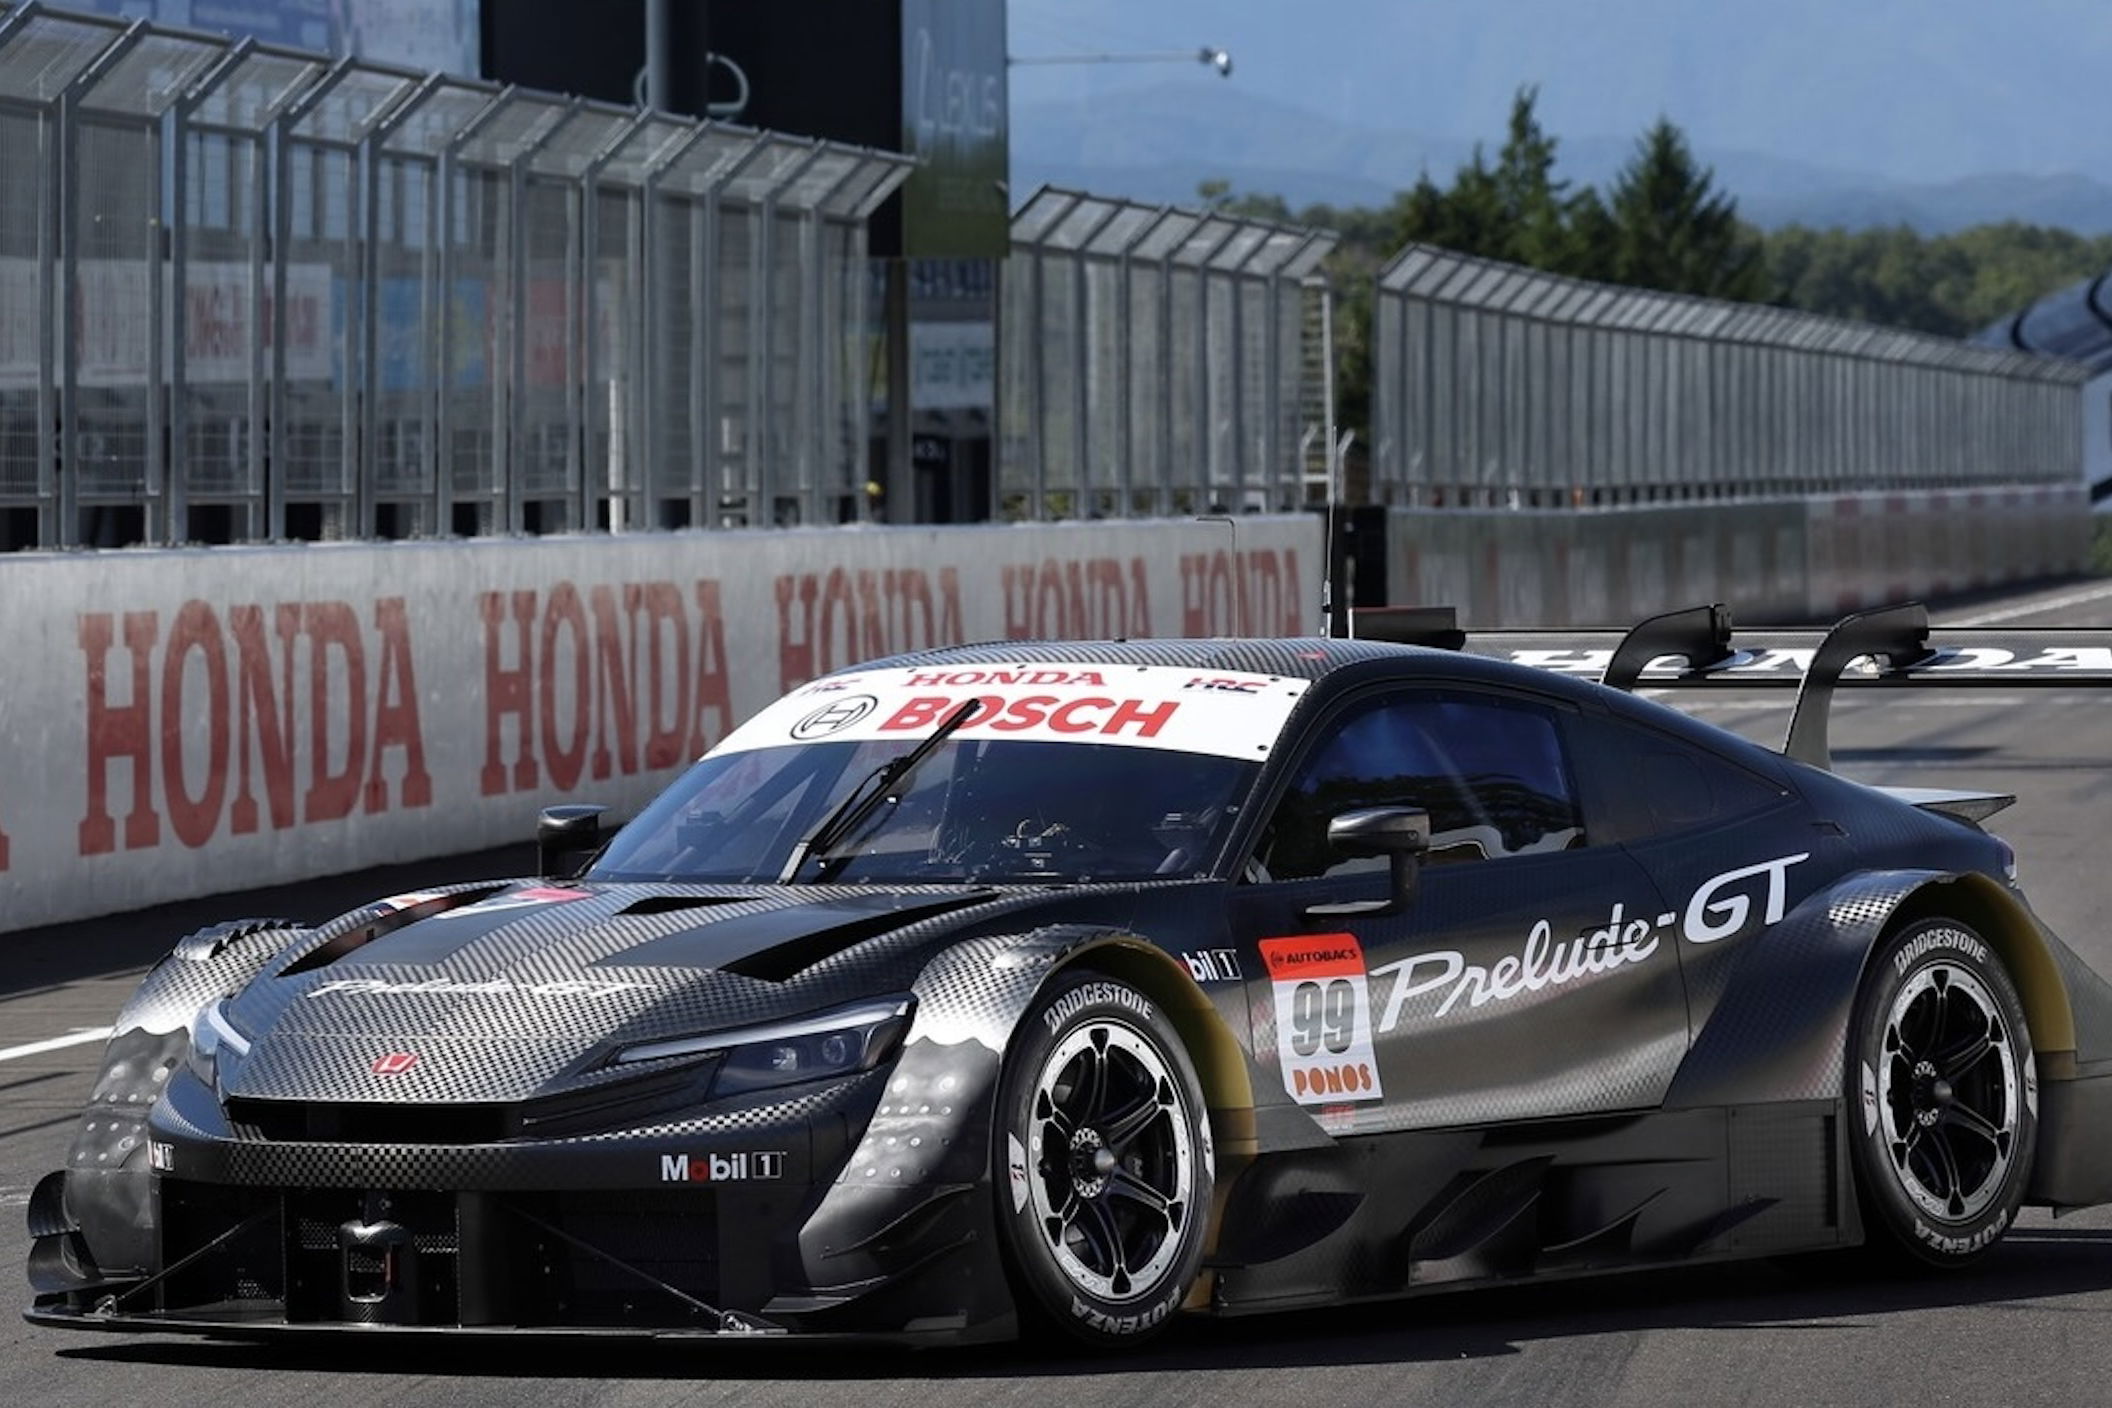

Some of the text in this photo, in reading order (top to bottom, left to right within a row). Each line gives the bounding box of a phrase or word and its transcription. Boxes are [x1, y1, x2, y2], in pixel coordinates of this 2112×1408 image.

[903, 670, 1107, 687] HONDA
[79, 597, 431, 856] HONDA
[480, 579, 734, 796] HONDA
[877, 695, 1181, 738] BOSCH
[1286, 948, 1357, 965] AUTOBACS
[1368, 852, 1810, 1034] Prelude-GT
[1894, 928, 1988, 977] BRIDGESTONE
[1043, 981, 1154, 1036] BRIDGESTONE
[1292, 979, 1355, 1056] 99
[1293, 1063, 1373, 1097] PONOS
[661, 1152, 748, 1182] Mobil
[1914, 1208, 2008, 1254] POTENZA
[1071, 1284, 1182, 1335] POTENZA
